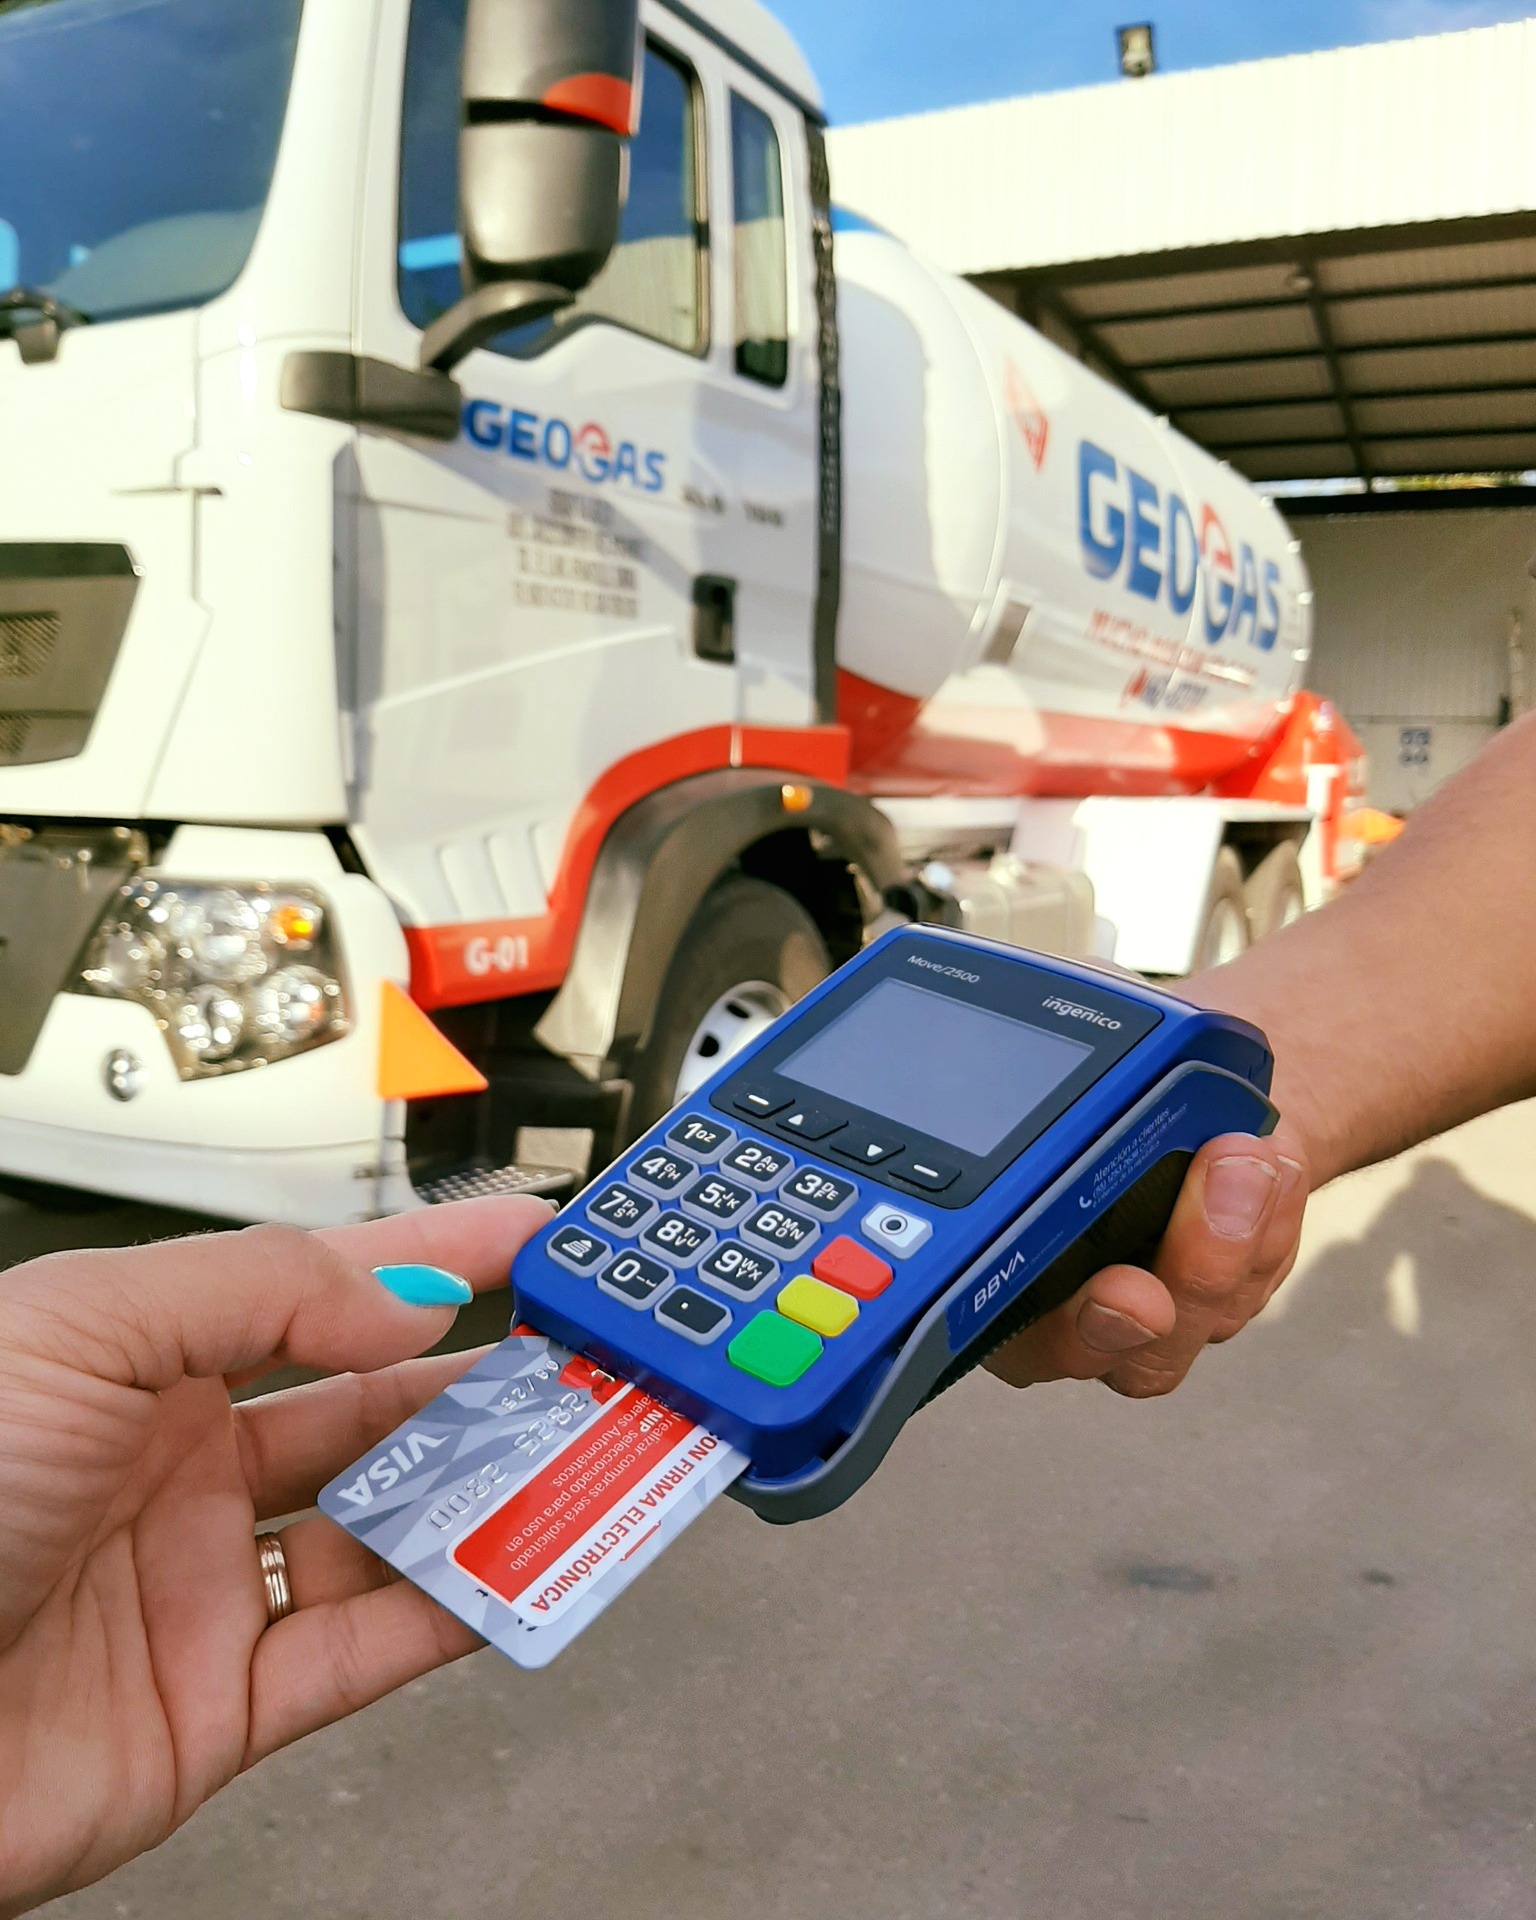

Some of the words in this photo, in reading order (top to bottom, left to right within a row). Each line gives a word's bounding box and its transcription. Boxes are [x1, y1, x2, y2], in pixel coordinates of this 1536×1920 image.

[462, 399, 667, 492] GEOGAS
[1077, 439, 1281, 652] GEOGAS
[463, 934, 529, 976] G-01
[906, 954, 981, 984] Move/2500
[1041, 995, 1122, 1031] ingenico
[973, 1251, 1026, 1314] BBVA
[513, 1391, 589, 1458] 2825
[634, 1418, 673, 1456] realizar
[640, 1408, 664, 1433] NIP
[336, 1431, 451, 1507] VISA
[569, 1429, 639, 1495] seleccionado
[688, 1431, 722, 1462] ON
[427, 1461, 509, 1530] 2800
[589, 1453, 636, 1498] compras
[638, 1457, 696, 1508] FIRMA
[522, 1515, 546, 1538] uso
[543, 1490, 572, 1518] para
[563, 1495, 591, 1522] será
[505, 1535, 524, 1552] en
[510, 1518, 567, 1571] solicitado
[530, 1504, 647, 1613] ELECTRÓNICA
